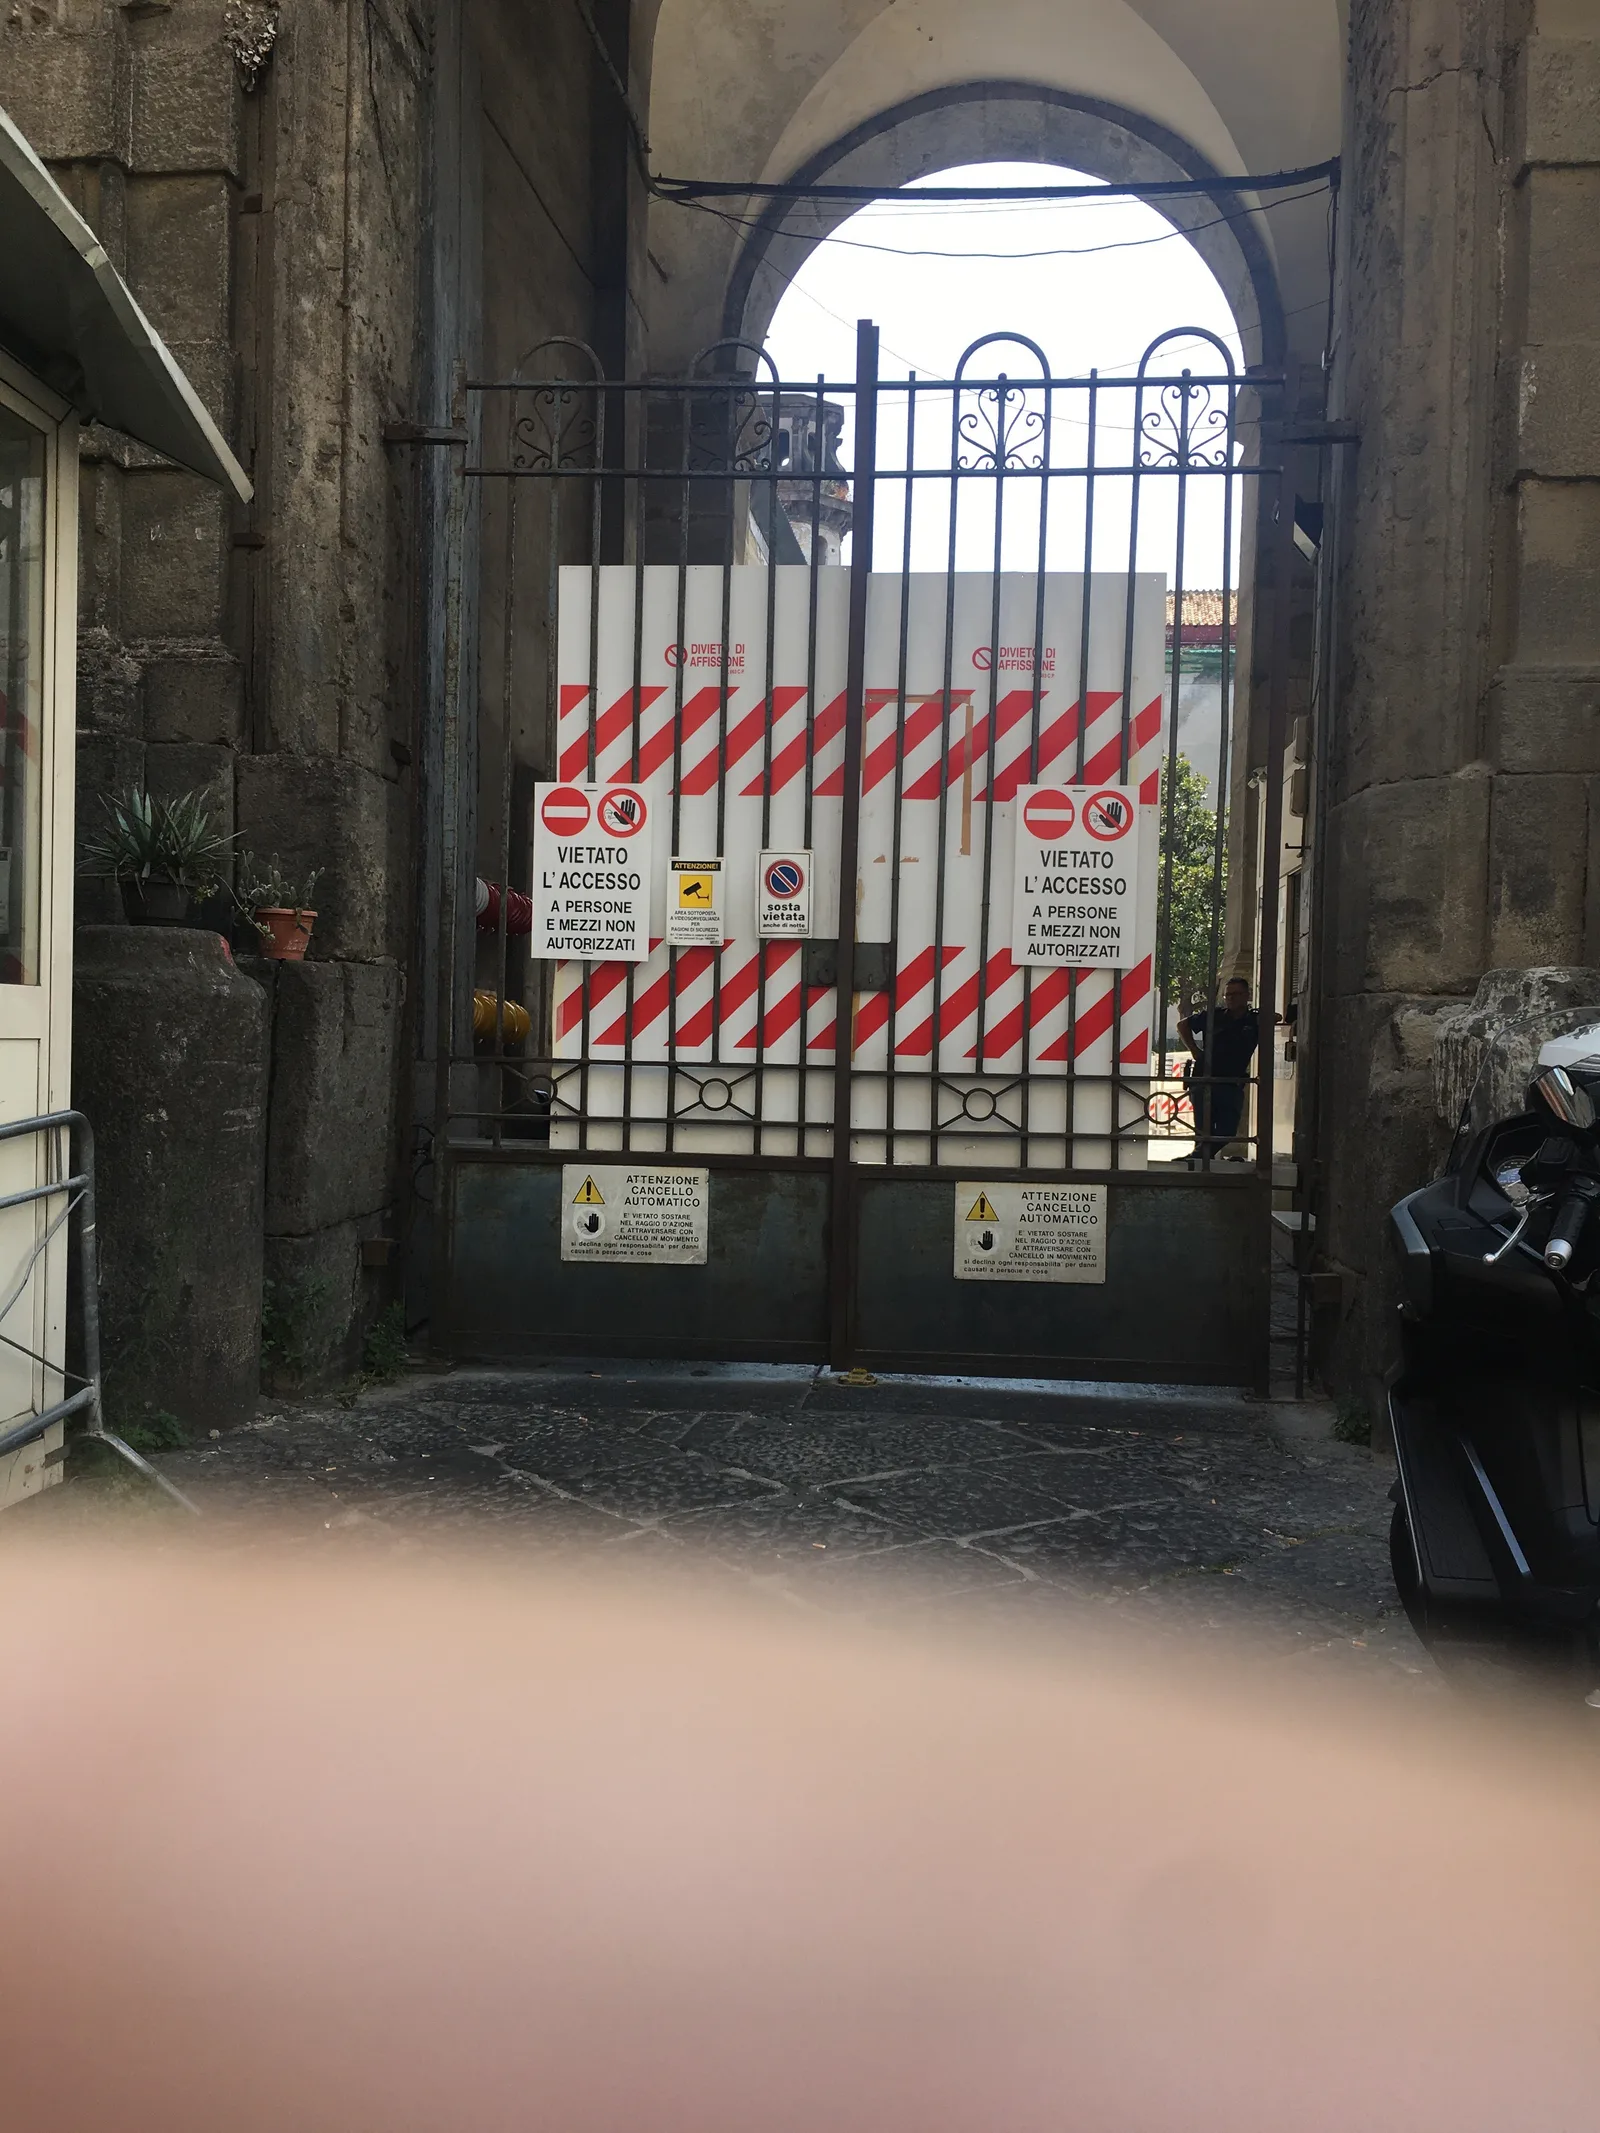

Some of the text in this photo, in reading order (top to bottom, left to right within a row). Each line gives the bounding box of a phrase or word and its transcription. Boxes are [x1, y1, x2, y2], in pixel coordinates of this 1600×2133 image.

[691, 644, 745, 654] DIVIET DI
[1045, 648, 1056, 658] DI
[690, 656, 745, 667] AFFISSONE
[998, 660, 1055, 671] AFFISSINE
[557, 846, 628, 864] VIETATO
[1040, 850, 1114, 869] VIETATO
[550, 900, 632, 914] A PERSONE
[767, 903, 801, 911] sosta
[1032, 905, 1117, 919] A PERSONE
[762, 912, 805, 921] vietata
[546, 919, 635, 932] E MEZZI NON
[1028, 925, 1121, 938] E MEZZI NON
[546, 937, 635, 951] AUTORIZZATI
[1027, 943, 1120, 958] AUTORIZZATI
[626, 1175, 700, 1185] ATTENZIONE
[631, 1186, 694, 1196] CANCELLO
[624, 1197, 700, 1207] AUTOMATICO
[1021, 1192, 1097, 1202] ATTENZIONE
[1026, 1203, 1091, 1213] CANCELLO
[1019, 1214, 1098, 1225] AUTOMATICO
